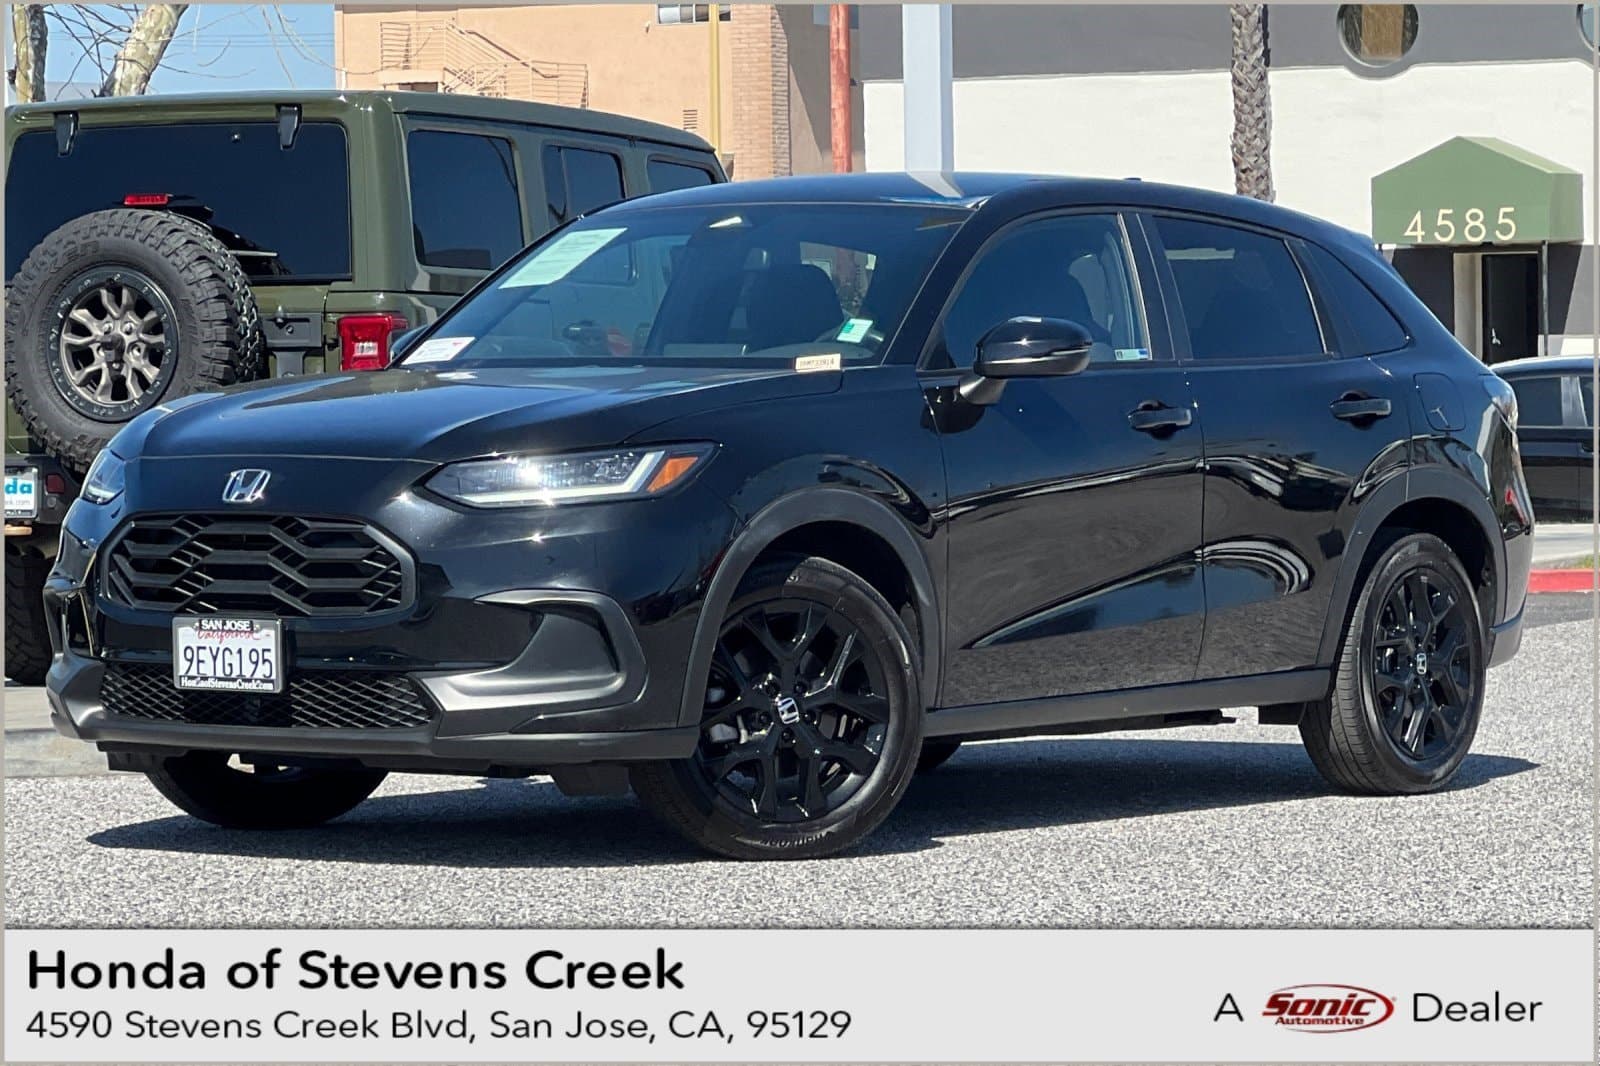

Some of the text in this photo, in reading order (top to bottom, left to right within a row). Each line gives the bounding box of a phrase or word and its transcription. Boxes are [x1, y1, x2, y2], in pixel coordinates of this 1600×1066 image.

[1403, 206, 1517, 243] 4585
[201, 619, 251, 631] SAN JOSE
[183, 645, 273, 679] 9EYG195
